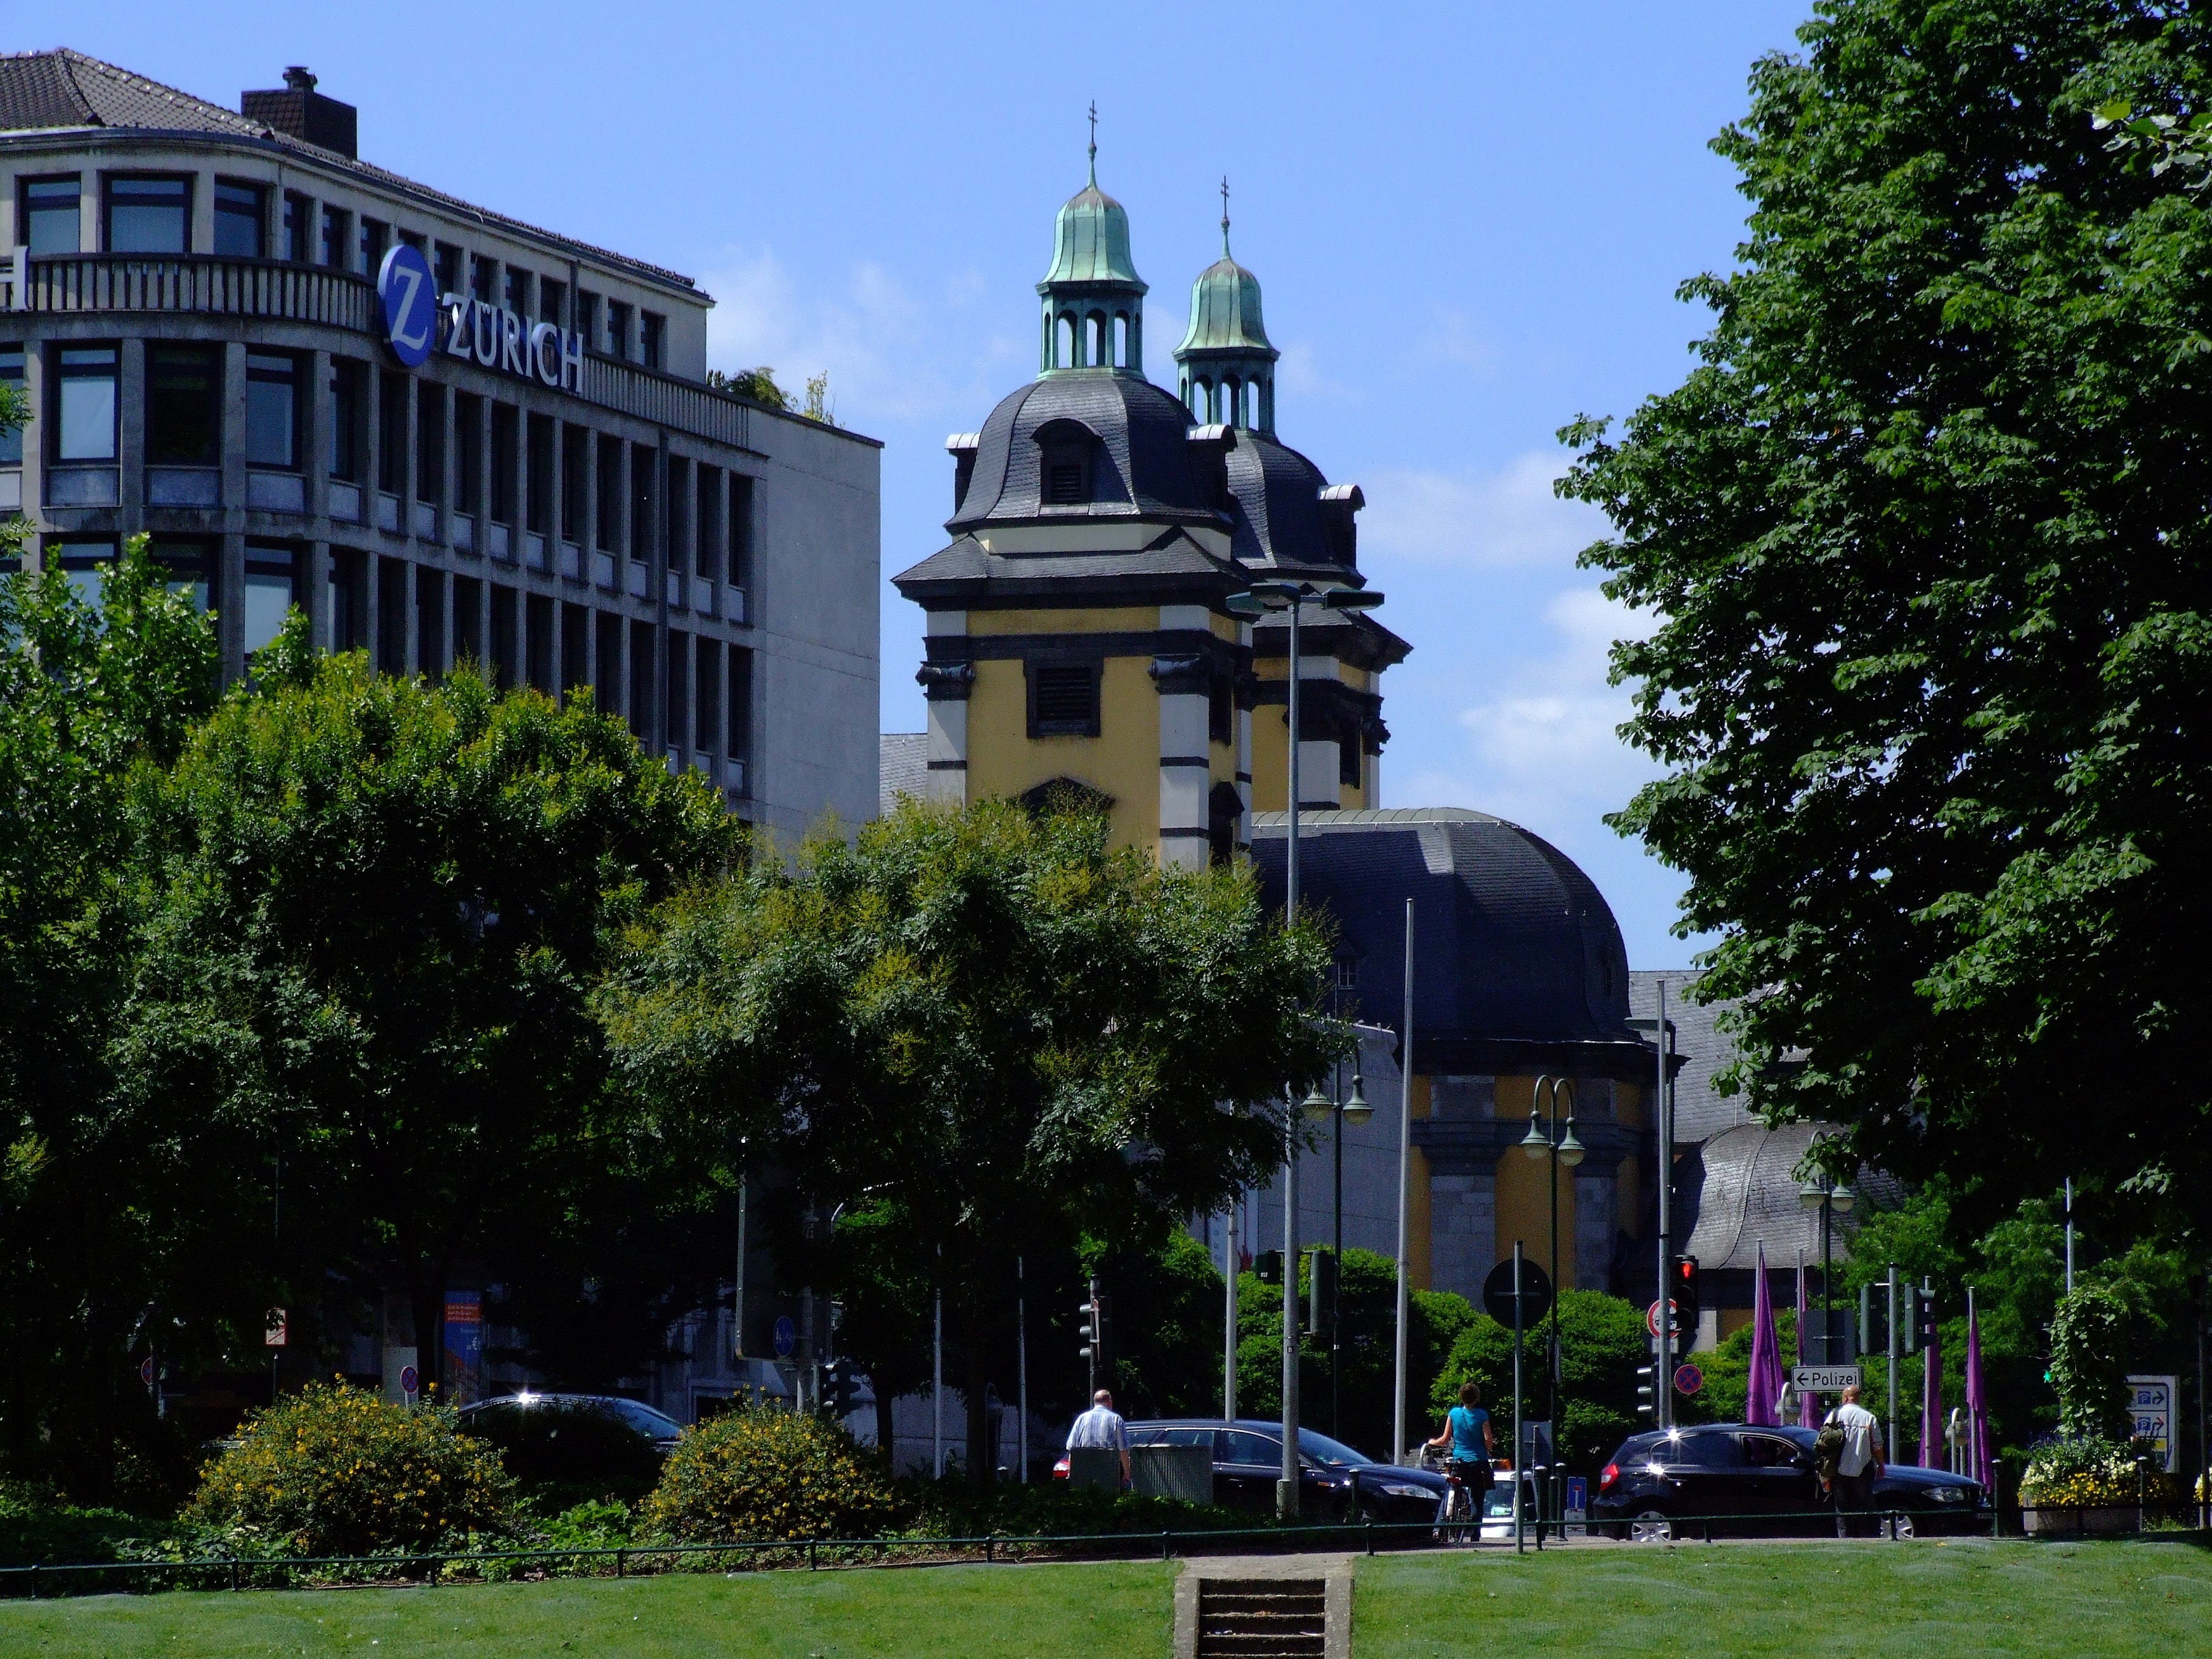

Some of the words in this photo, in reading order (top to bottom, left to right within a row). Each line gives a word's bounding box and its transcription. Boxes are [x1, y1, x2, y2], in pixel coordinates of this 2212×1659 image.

[391, 266, 428, 351] Z
[442, 292, 583, 394] ZÜRICH
[1812, 1372, 1857, 1386] Polizei
